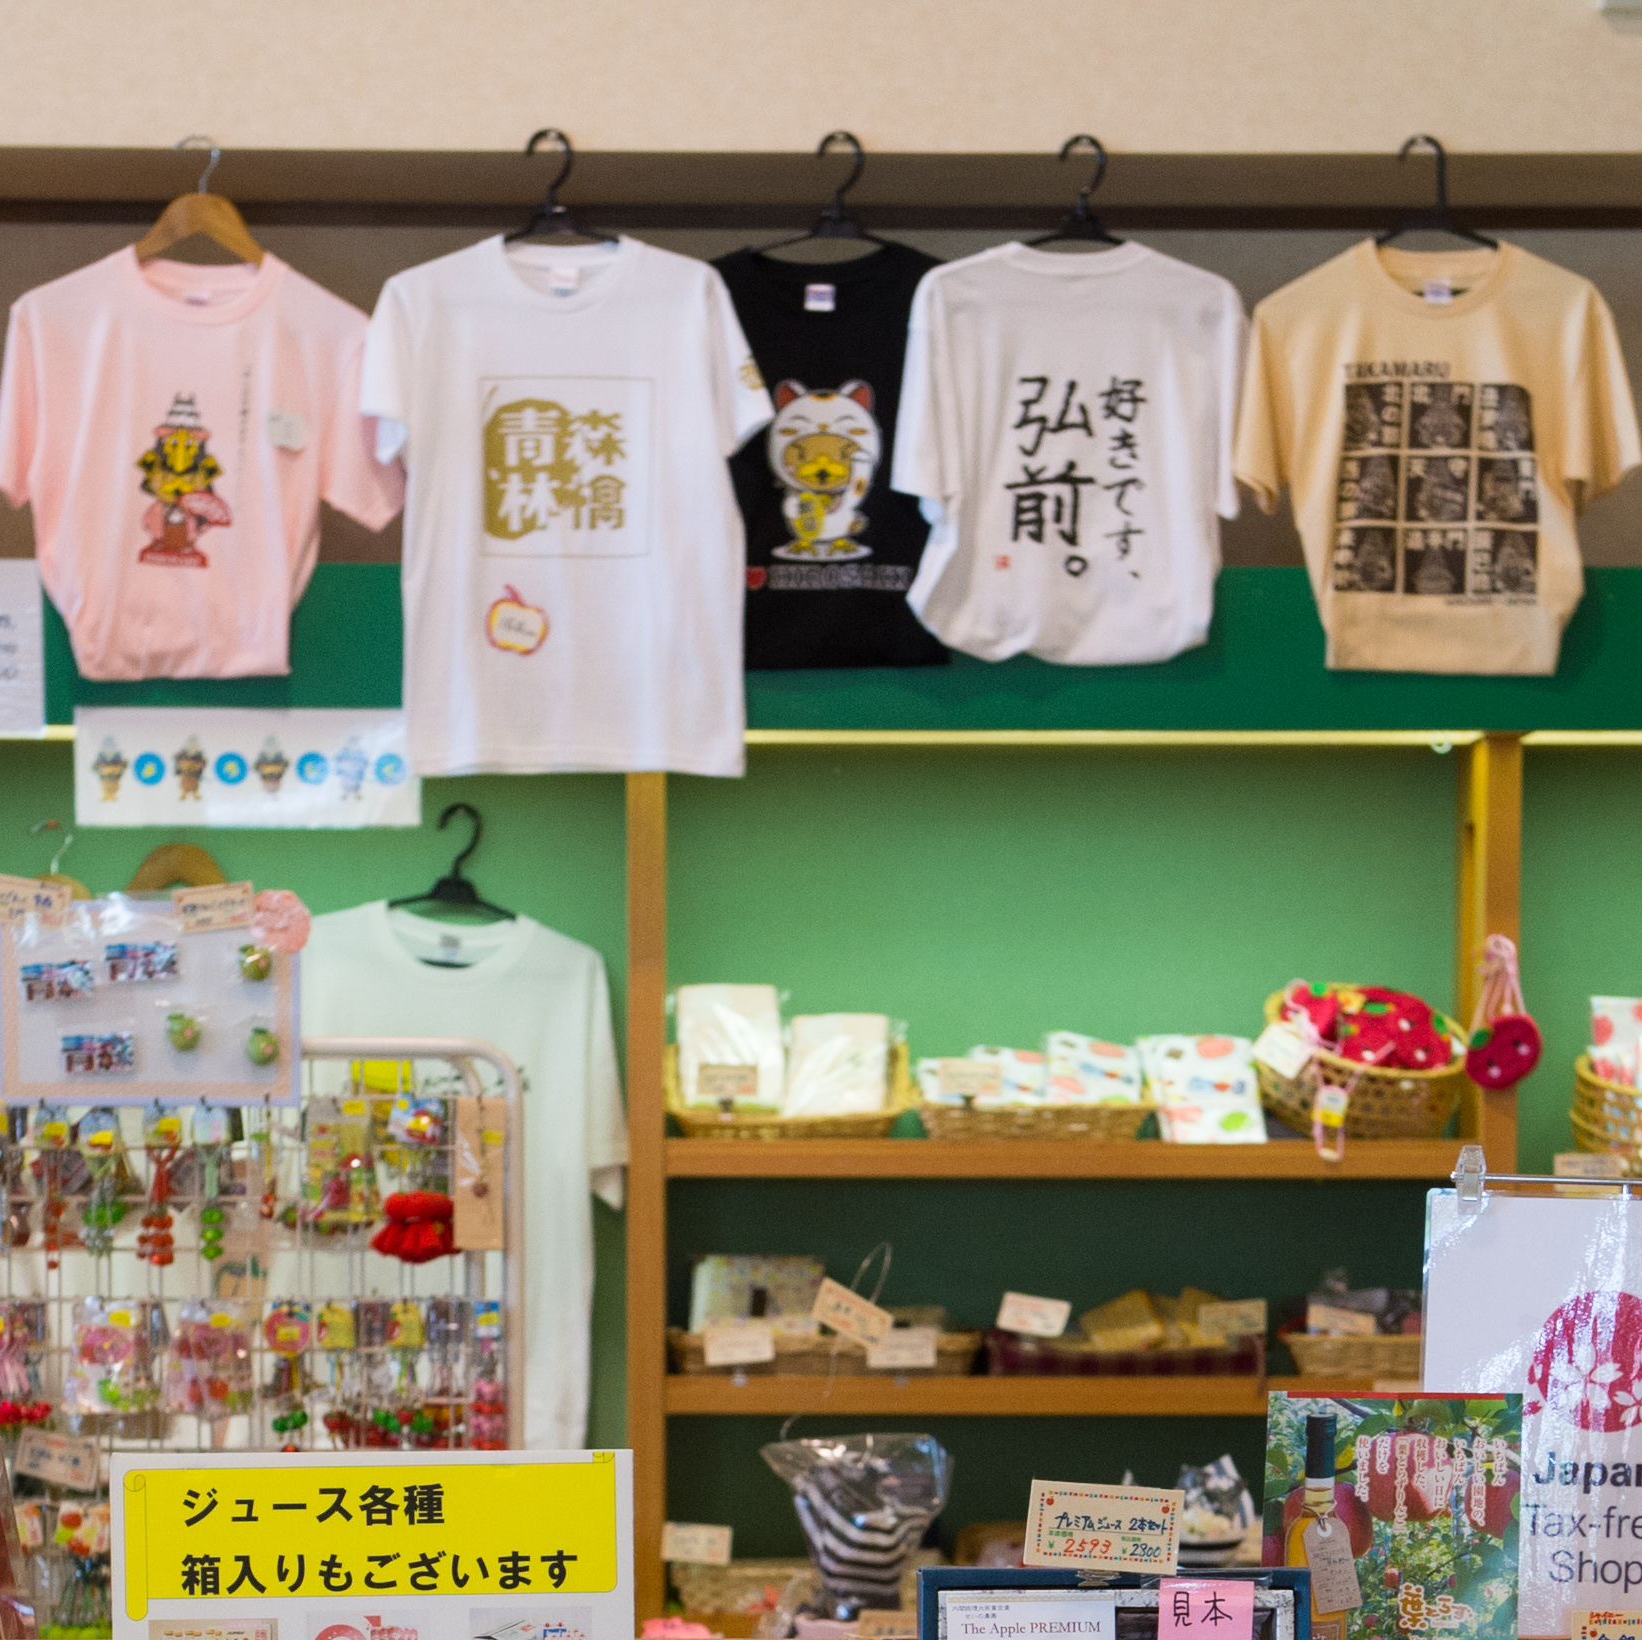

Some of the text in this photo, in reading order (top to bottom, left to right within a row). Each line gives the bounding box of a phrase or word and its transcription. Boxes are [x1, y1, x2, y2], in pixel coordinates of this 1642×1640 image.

[1004, 376, 1098, 580] 弘前。
[180, 1484, 447, 1528] ジュース各種
[1063, 1537, 1113, 1556] 2593
[179, 1548, 580, 1597] 箱入りもございます
[961, 1621, 1102, 1638] The Apple PREMIUM
[1172, 1591, 1233, 1628] 見本
